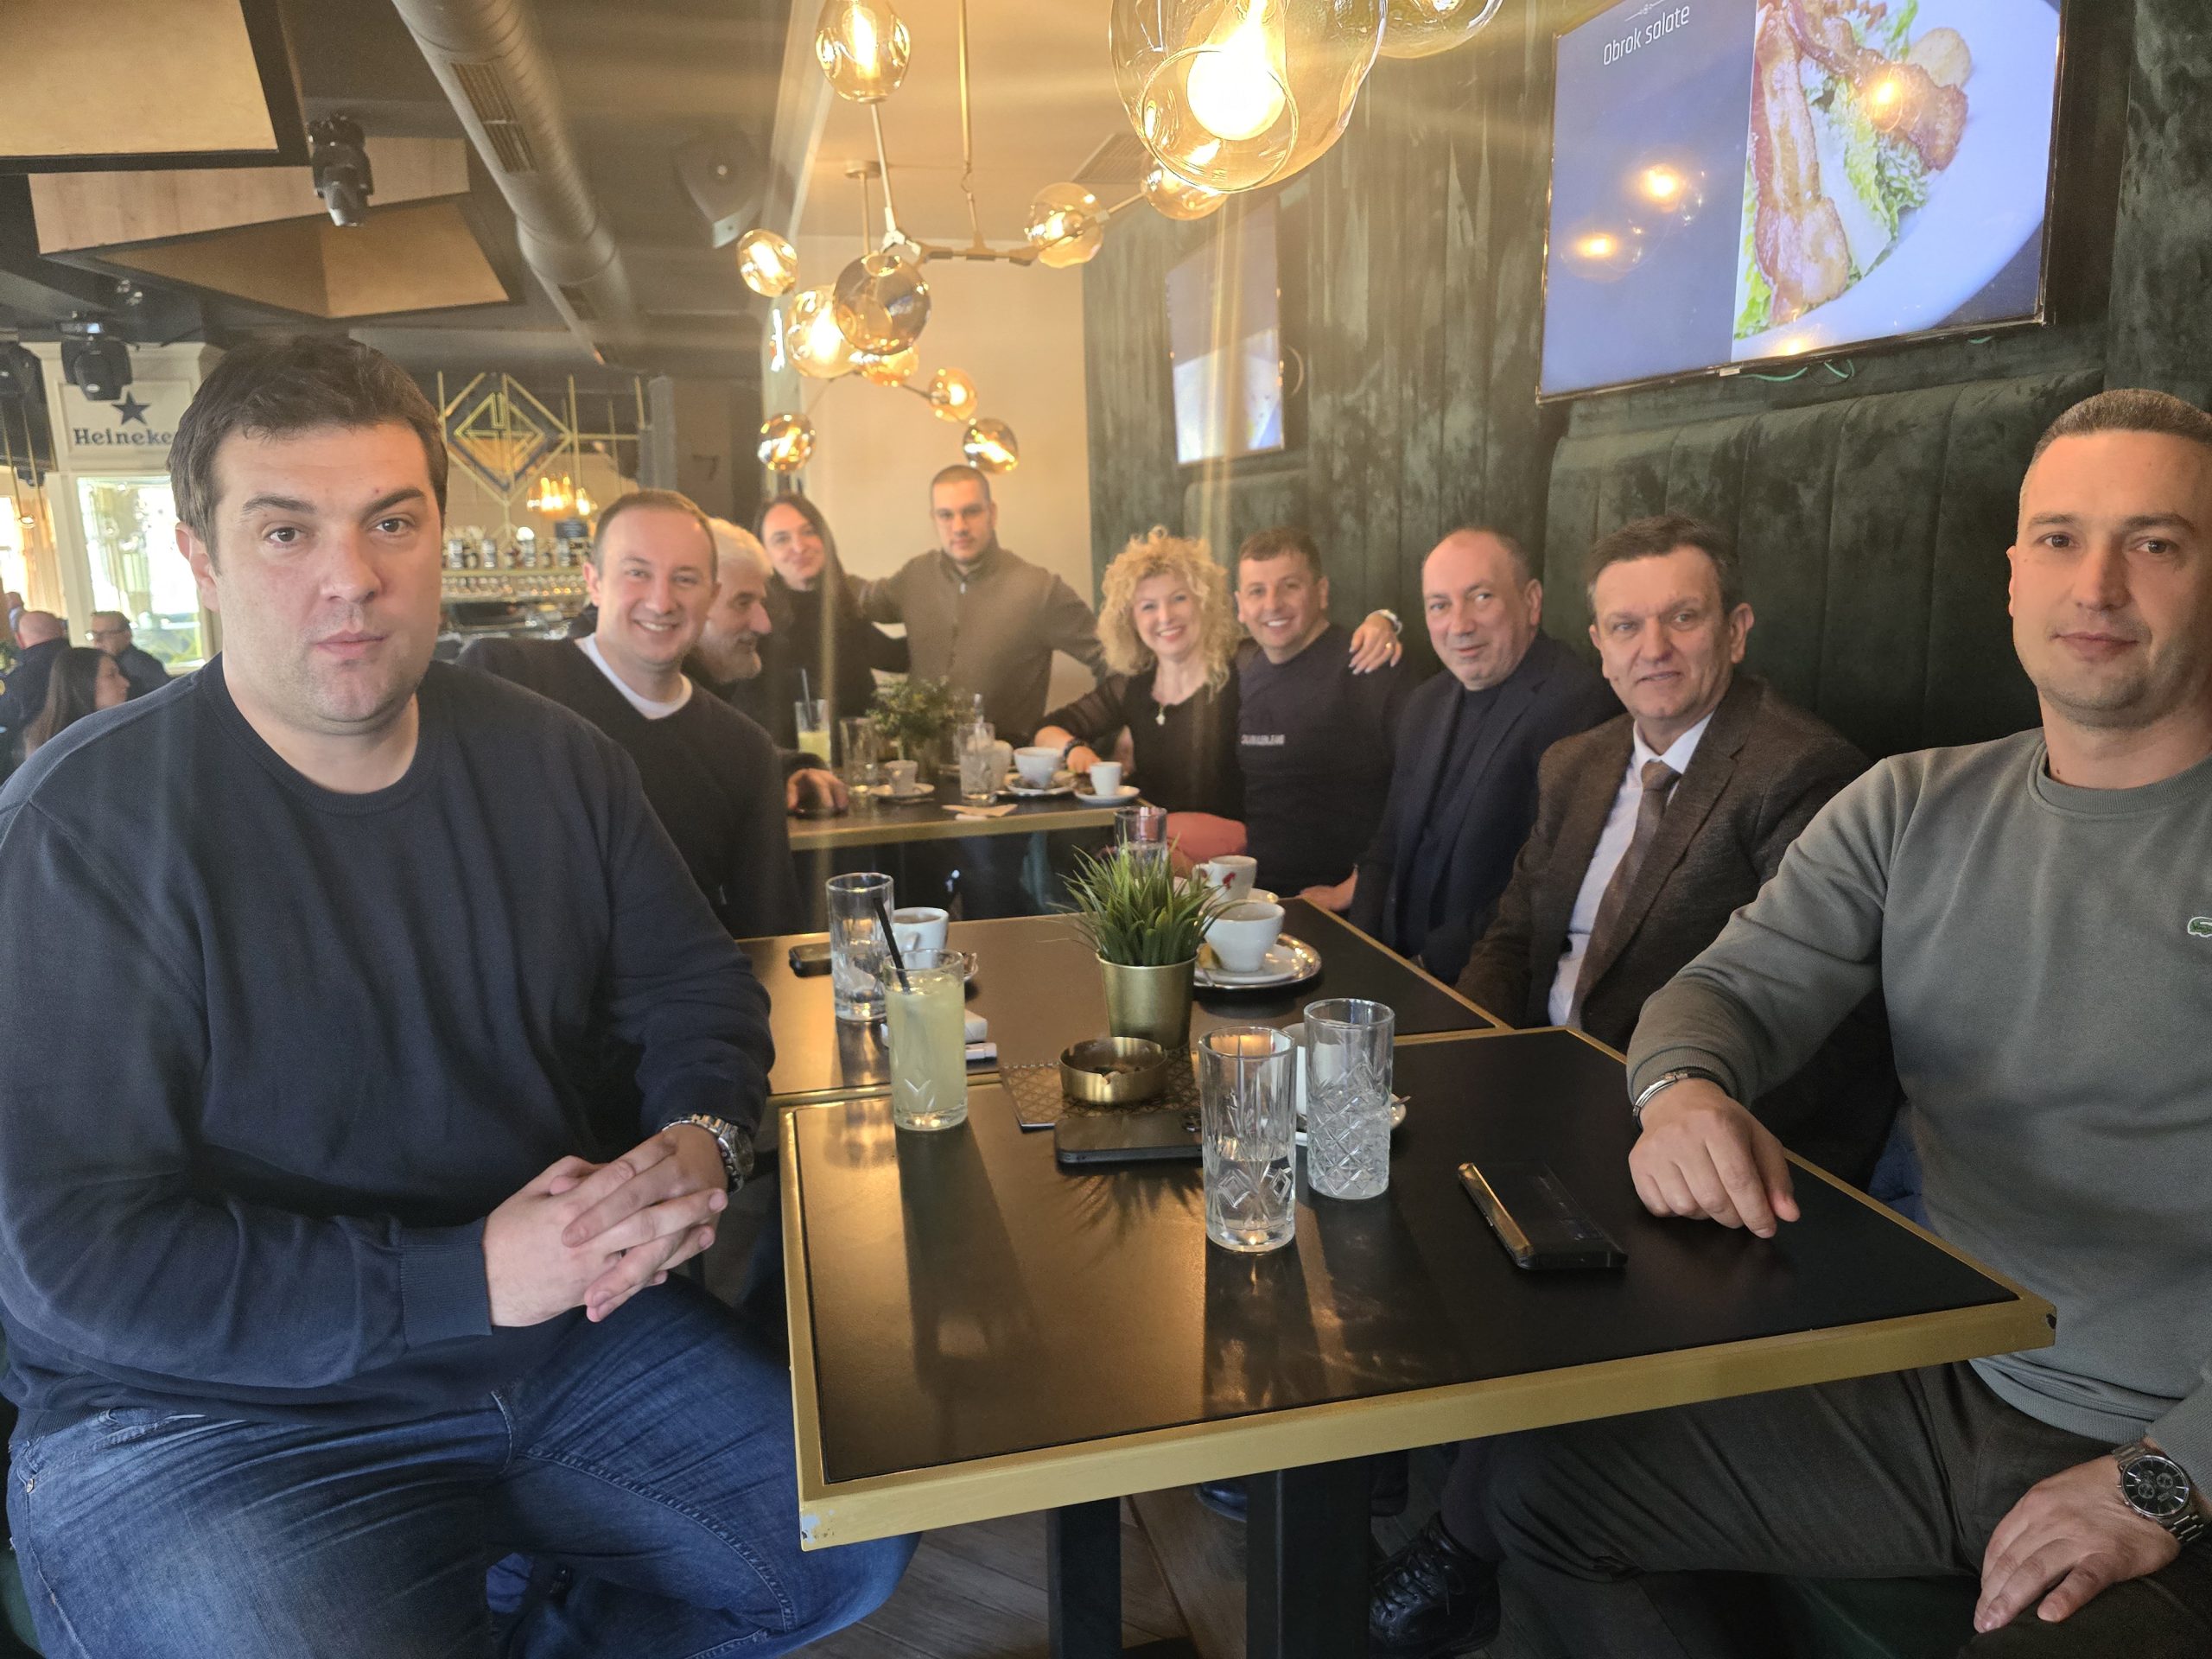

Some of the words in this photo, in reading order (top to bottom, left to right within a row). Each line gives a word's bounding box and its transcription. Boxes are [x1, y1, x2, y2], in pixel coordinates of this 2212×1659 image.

[1603, 28, 1642, 66] Obrok
[1645, 5, 1690, 44] salate
[73, 428, 174, 445] Heineke
